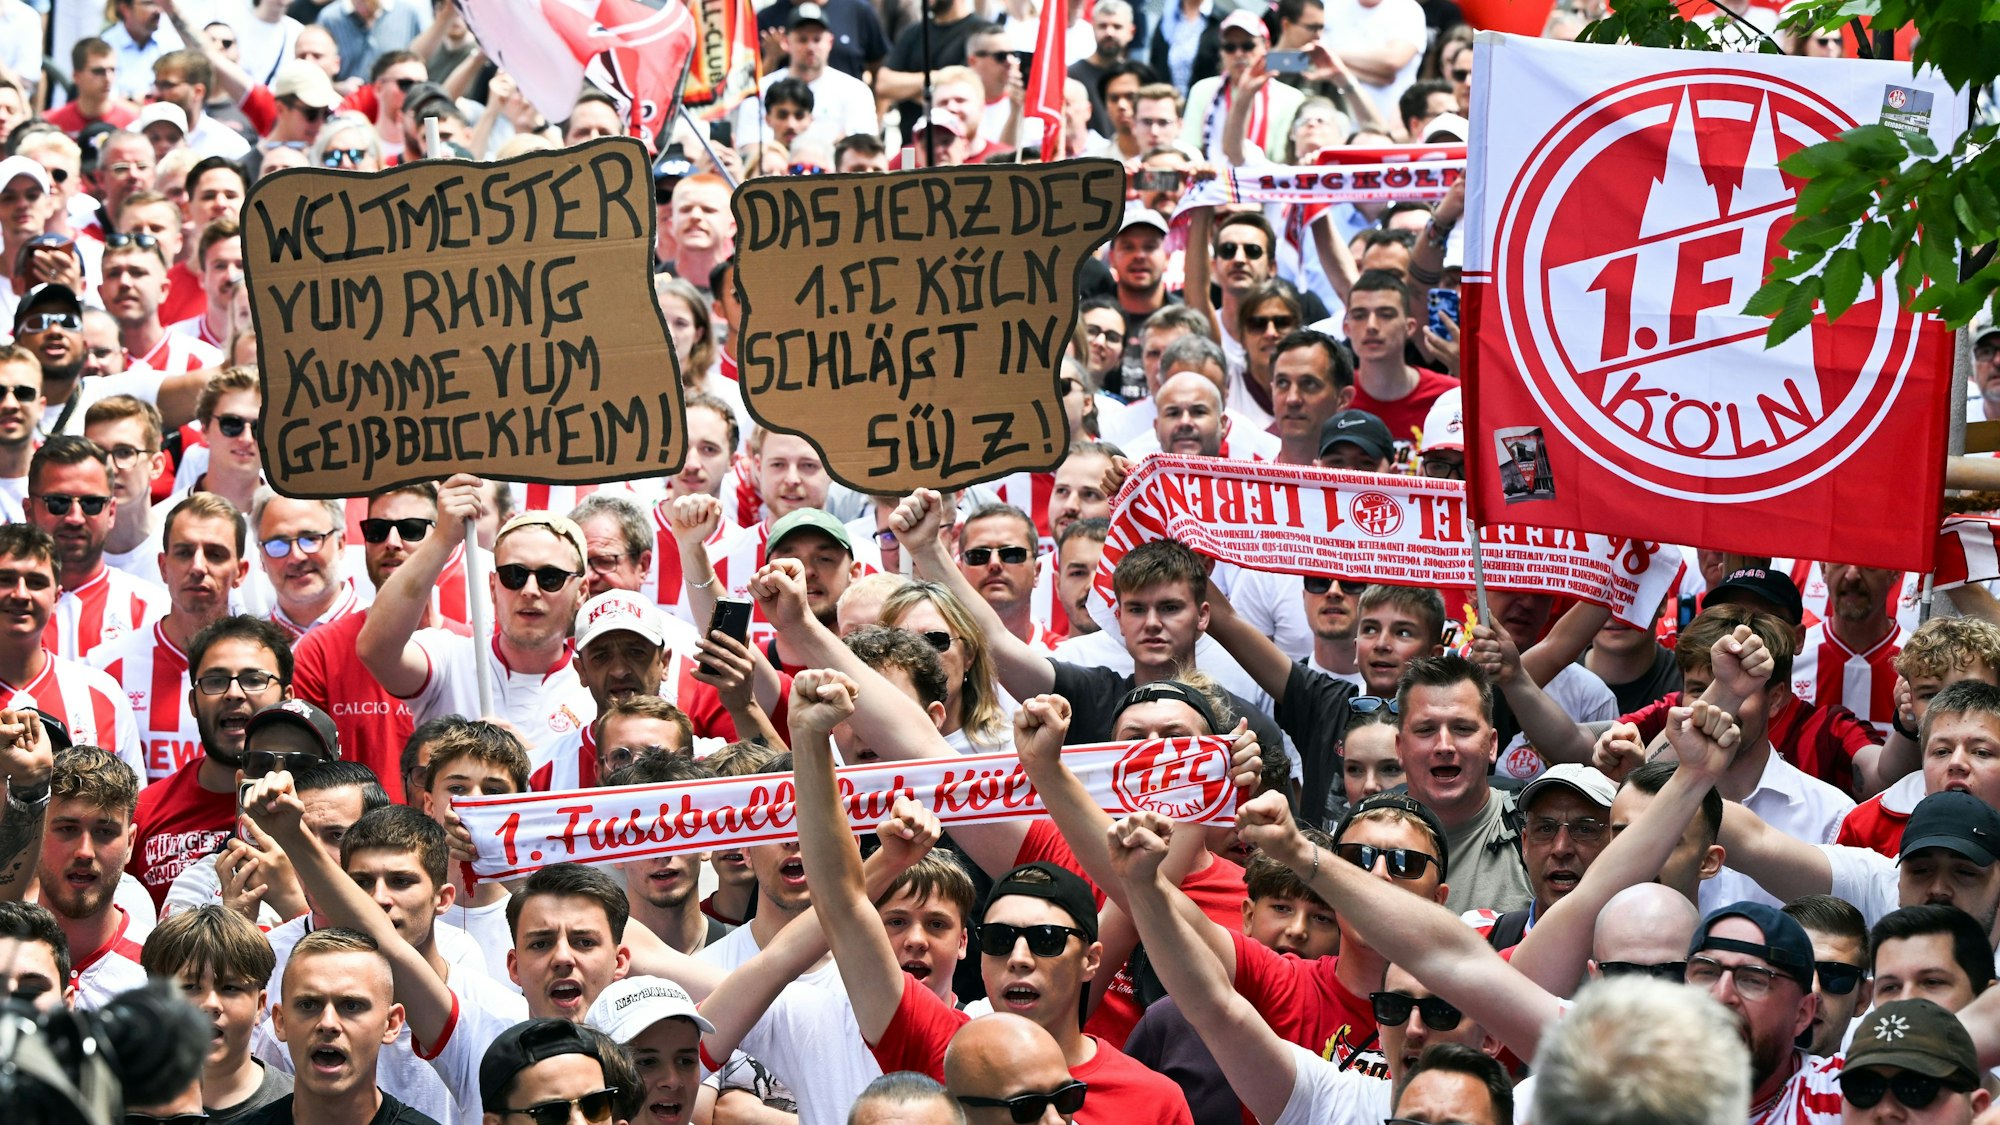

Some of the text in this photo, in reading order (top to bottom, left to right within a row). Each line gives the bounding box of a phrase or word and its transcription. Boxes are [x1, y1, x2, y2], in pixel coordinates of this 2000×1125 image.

[1259, 172, 1344, 190] 1.FC
[254, 152, 642, 263] WELTMEISTER
[744, 170, 1114, 251] DAS HERZ DES
[795, 245, 1060, 318] 1.FC KÖLN
[1586, 213, 1810, 362] 1.F
[402, 256, 589, 338] RHING
[746, 315, 1058, 400] SCHLÄGT IN
[282, 347, 470, 416] KUMME
[1602, 371, 1815, 457] KÖLN
[1257, 467, 1300, 479] LONGERICH
[1302, 471, 1375, 487] BILDERSTÖCKCHEN
[1377, 477, 1423, 488] STAMMHEIM
[1425, 479, 1460, 491] MÜLHEIM
[1320, 486, 1345, 533] 1
[1362, 504, 1392, 523] 1.FC
[1210, 529, 1311, 543] ROGGENDORF/THENHOVEN
[1313, 536, 1356, 549] MERKENICH
[1262, 543, 1314, 555] ALTSTADT-SÜD
[1358, 540, 1404, 551] LINDWEILER
[1406, 543, 1459, 556] HEIMERSDORF
[1244, 554, 1296, 565] JUNKERSDORF
[1317, 548, 1375, 561] ALTSTADT-NORD
[1377, 553, 1421, 566] VOGELSANG
[1505, 550, 1567, 563] ESCH/AUWEILER
[1298, 557, 1344, 571] BRAUNSFELD
[1346, 564, 1372, 574] VINGST
[1423, 557, 1466, 568] OSSENDORF
[1569, 555, 1611, 574] CHORWEILER
[1374, 565, 1430, 578] RATH/HEUMAR
[1433, 571, 1466, 580] OSTHEIM
[1527, 564, 1569, 576] EHRENFELD
[1726, 568, 1766, 583] 1948
[1509, 575, 1543, 586] MERHEIM
[1546, 577, 1566, 589] KALK
[333, 701, 391, 716] CALCIO
[1137, 753, 1213, 794] 1.FC
[1139, 797, 1204, 818] KÖLN
[495, 811, 543, 867] 1.
[545, 781, 797, 856] Fussball
[838, 775, 915, 820] lub
[615, 992, 641, 1011] NEW
